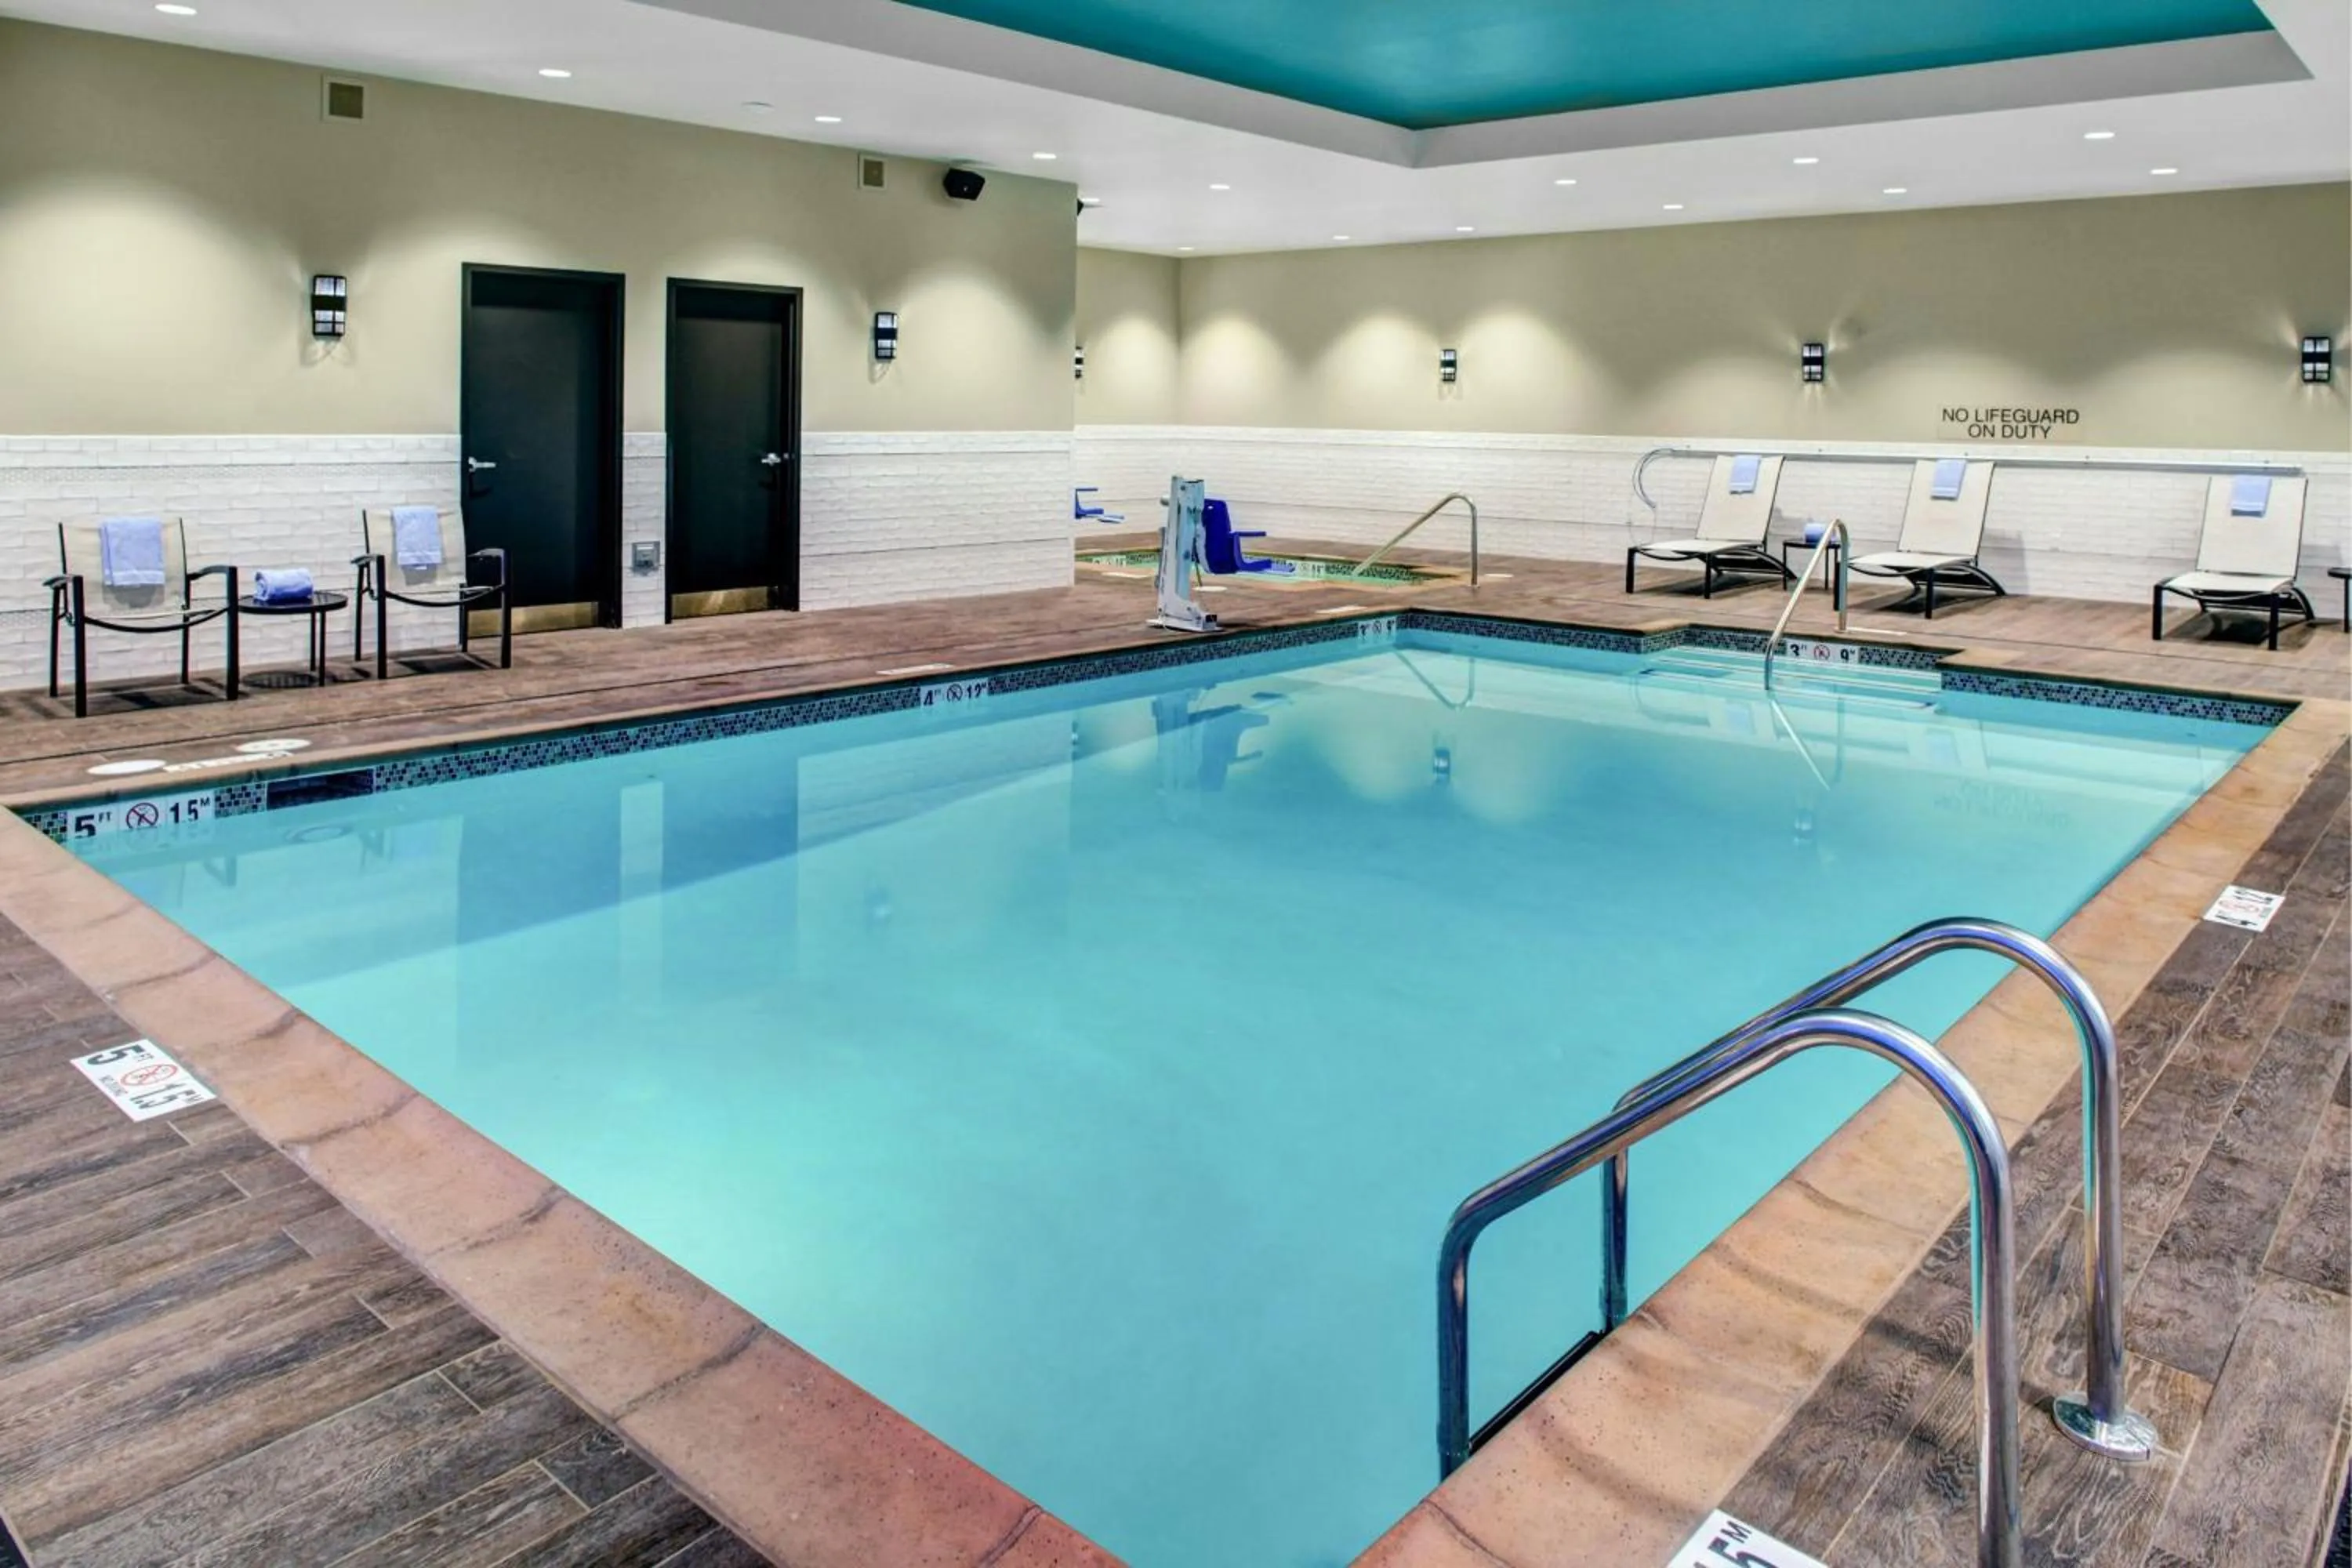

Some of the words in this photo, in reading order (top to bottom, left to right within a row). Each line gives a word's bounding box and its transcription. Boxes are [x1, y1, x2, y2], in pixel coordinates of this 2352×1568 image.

[1942, 408, 1969, 423] NO
[1974, 408, 2080, 424] LIFEGUARD
[1968, 423, 1995, 438] ON
[2002, 424, 2051, 439] DUTY
